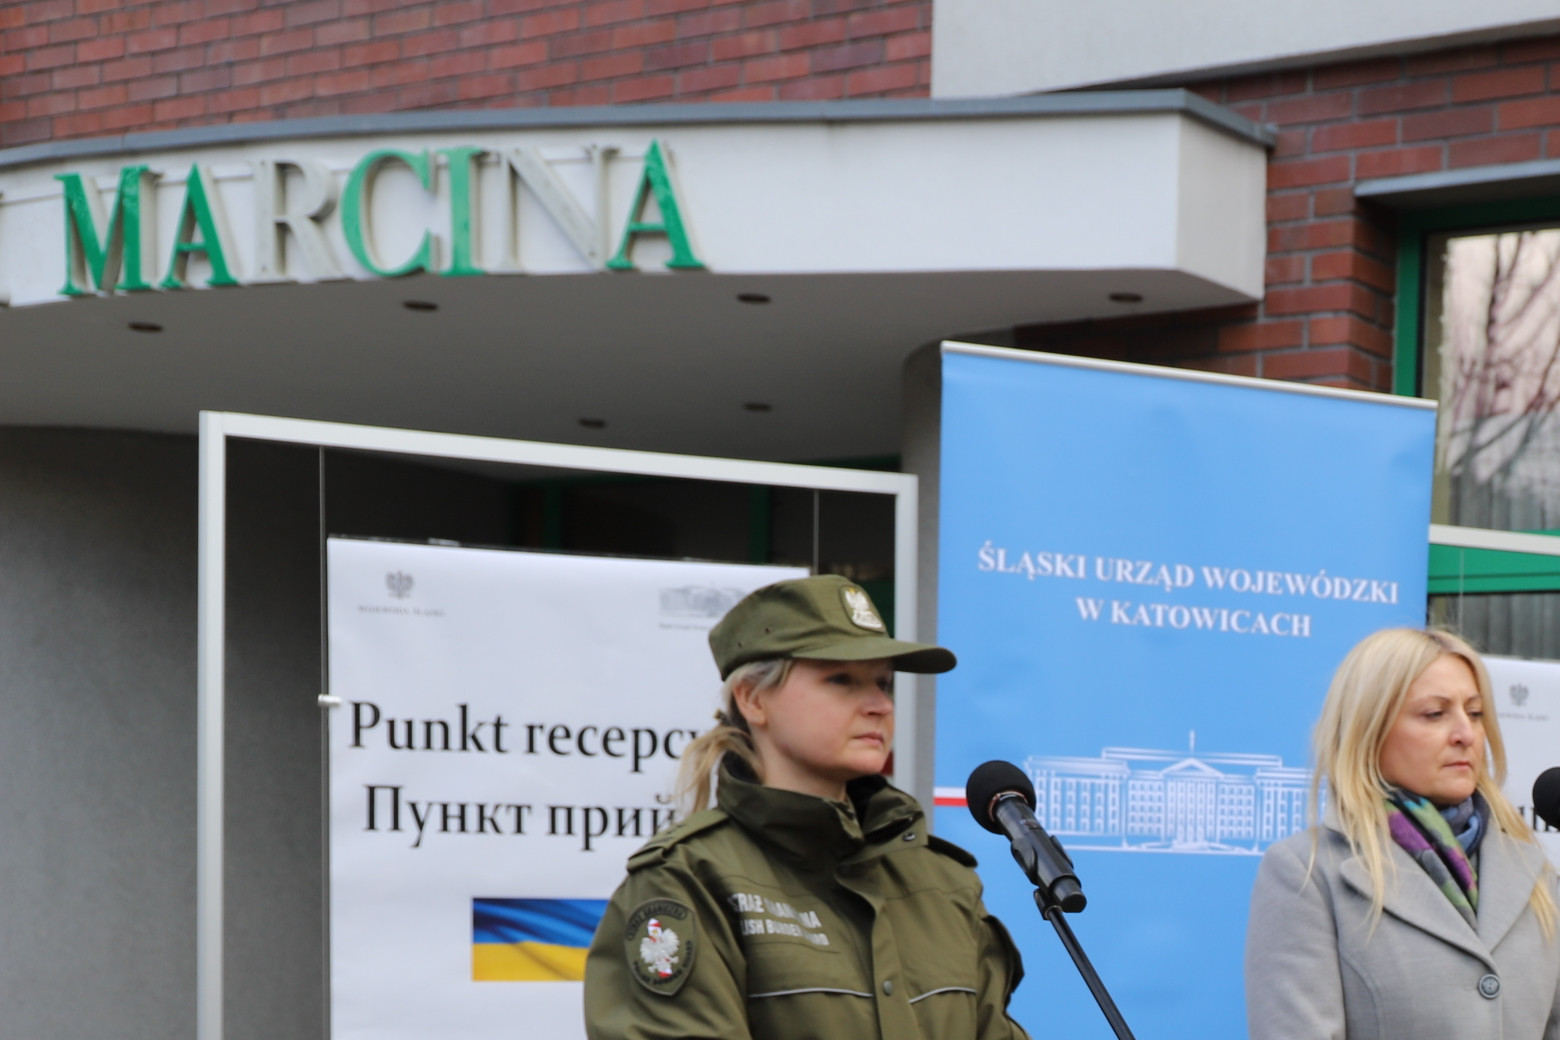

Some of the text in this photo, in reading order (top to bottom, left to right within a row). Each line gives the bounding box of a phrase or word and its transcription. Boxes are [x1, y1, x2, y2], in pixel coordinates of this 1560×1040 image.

[53, 138, 707, 297] MARCINA
[978, 541, 1399, 605] ŚLĄSKI URZĄD WOJEWÓDZKI
[1076, 597, 1313, 638] W KATOWICACH
[350, 701, 698, 774] Punkt recepc
[364, 784, 532, 848] Пункт
